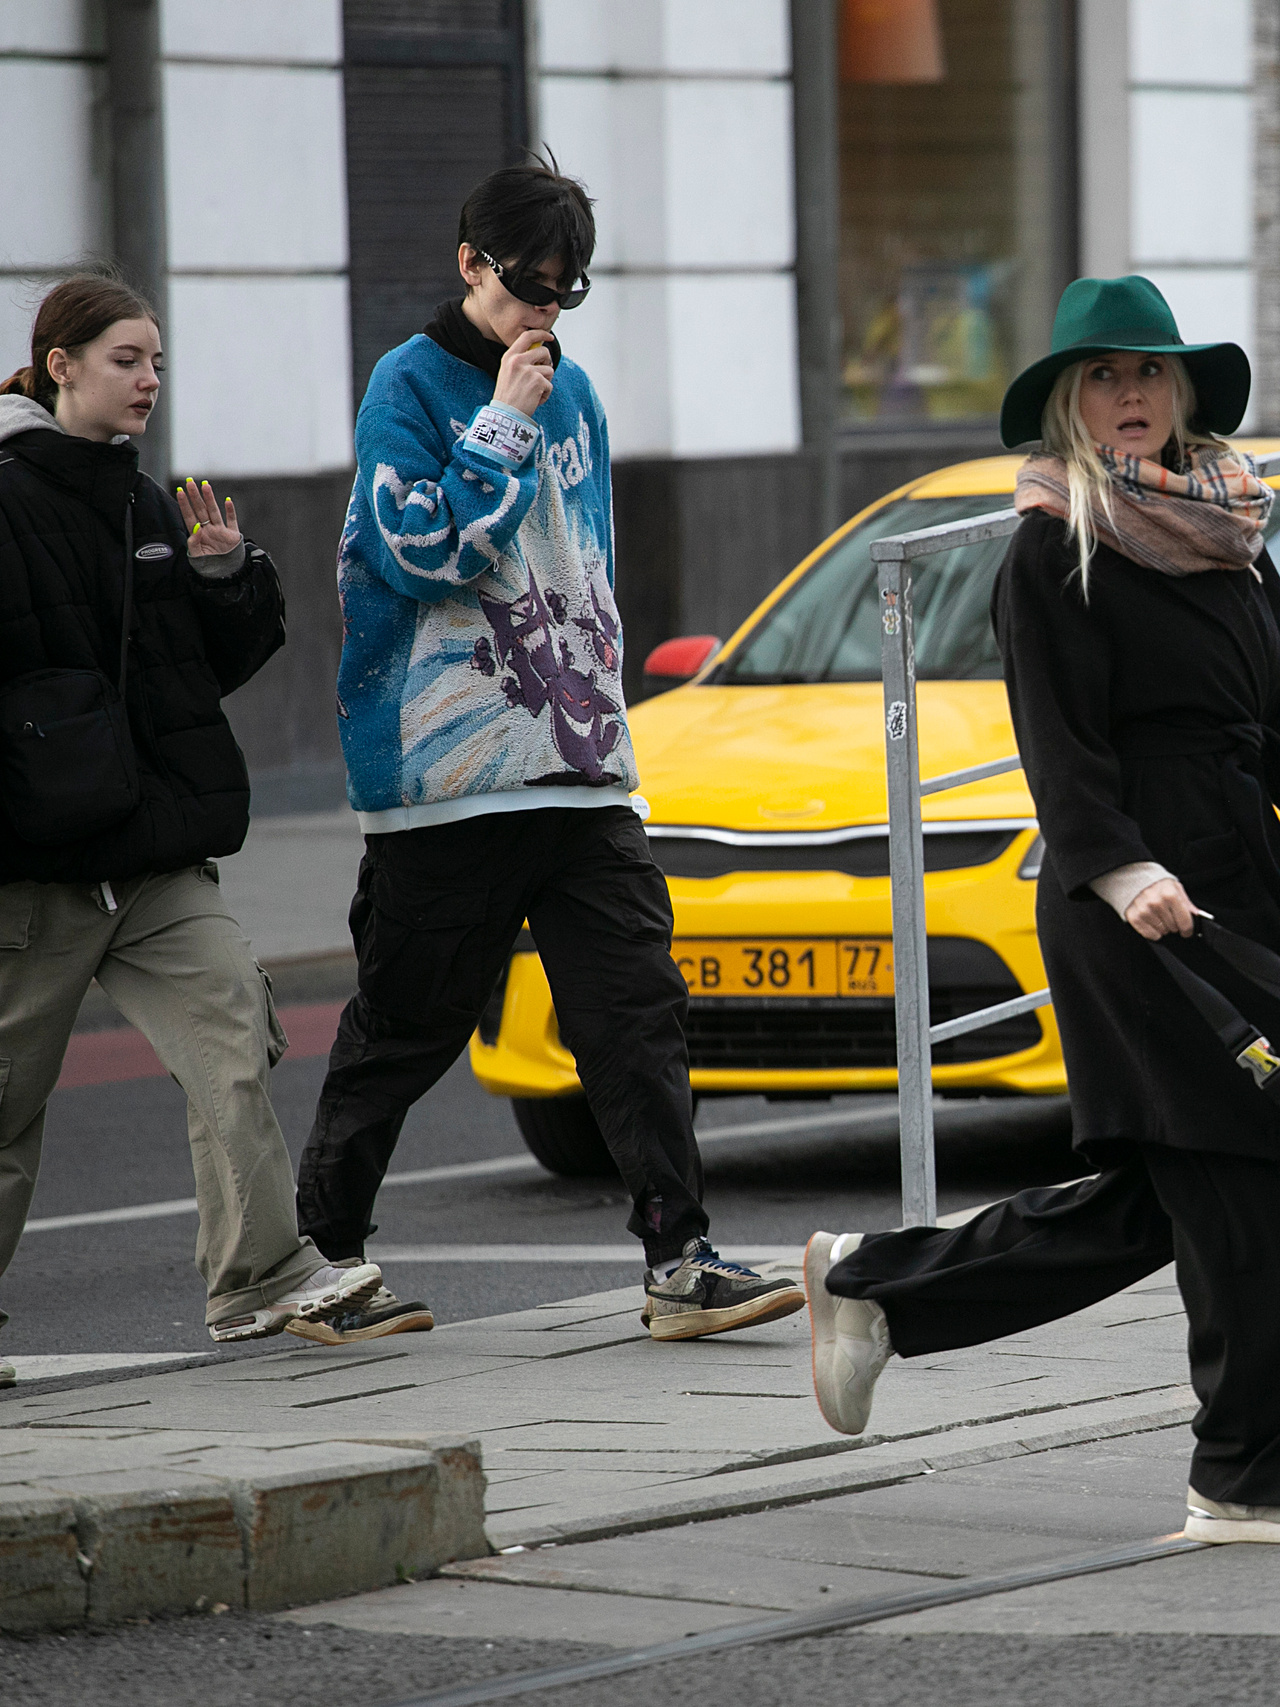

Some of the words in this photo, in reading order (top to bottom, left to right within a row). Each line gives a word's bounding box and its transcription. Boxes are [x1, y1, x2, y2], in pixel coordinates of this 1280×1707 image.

[742, 947, 817, 988] 381
[844, 946, 881, 976] 77
[849, 978, 877, 990] RUS
